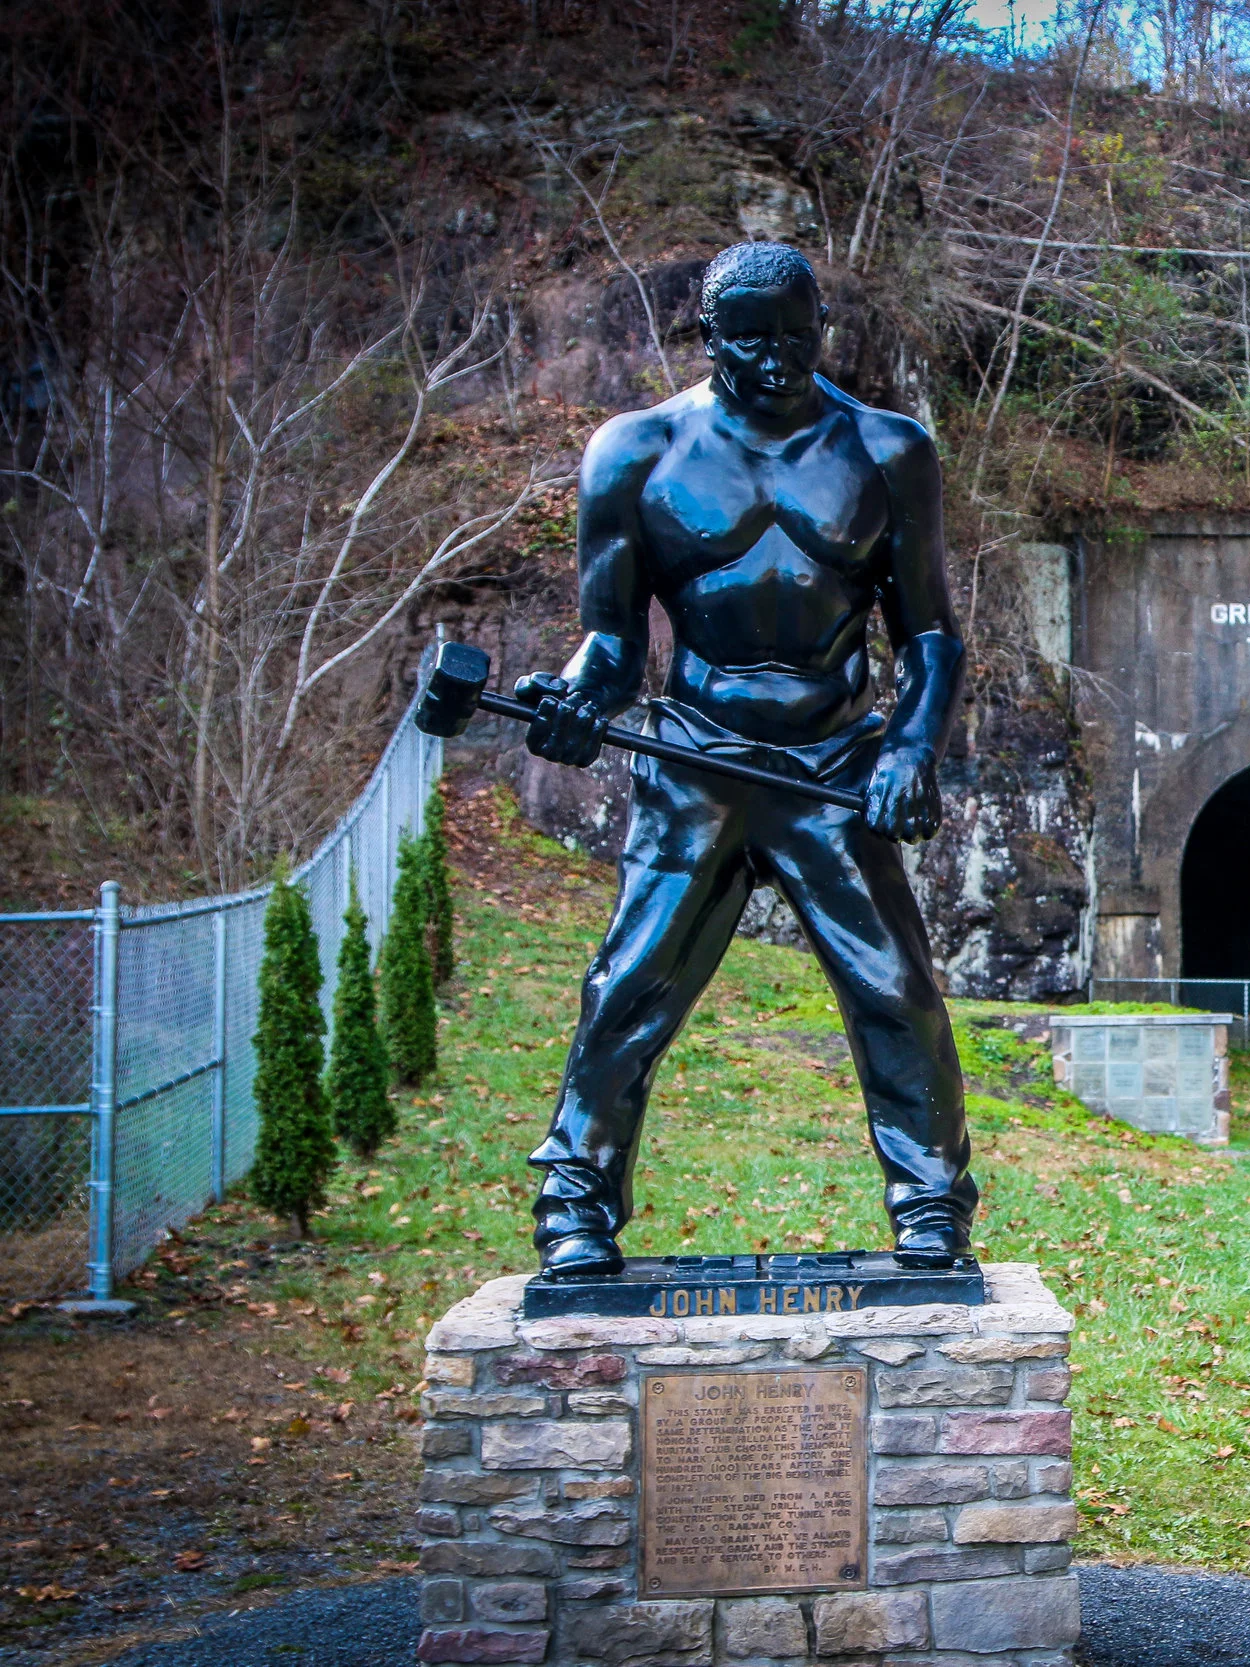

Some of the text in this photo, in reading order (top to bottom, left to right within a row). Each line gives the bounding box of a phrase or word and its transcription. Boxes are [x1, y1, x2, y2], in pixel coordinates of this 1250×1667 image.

[649, 1285, 866, 1317] JOHN HENRY
[695, 1383, 815, 1401] JOHN HENRY
[667, 1408, 689, 1417] THIS
[694, 1407, 732, 1416] STATUE
[738, 1406, 759, 1415] WAS
[764, 1405, 810, 1414] ERECTED
[656, 1413, 851, 1427] BY A GROUP OF PEOPLE WITH THE
[656, 1427, 684, 1436] SAME
[774, 1424, 787, 1433] AS
[792, 1423, 812, 1431] THE
[841, 1422, 851, 1430] IT
[712, 1435, 731, 1444] THE
[737, 1434, 787, 1443] HILLDALE
[705, 1445, 729, 1453] CLUB
[735, 1444, 769, 1452] CHOSE
[774, 1442, 795, 1451] THIS
[800, 1441, 851, 1450] MEMORIAL
[656, 1455, 671, 1464] TO
[678, 1455, 706, 1463] MARK
[714, 1454, 721, 1462] A
[728, 1453, 754, 1462] PAGE
[761, 1452, 775, 1460] OF
[831, 1449, 851, 1458] ONE
[656, 1464, 703, 1474] HUNDRED
[746, 1462, 781, 1471] YEARS
[790, 1461, 823, 1469] AFTER
[832, 1460, 851, 1468] THE
[656, 1473, 721, 1483] COMPLETION
[725, 1472, 739, 1480] OF
[743, 1471, 762, 1480] THE
[765, 1471, 782, 1479] BIG
[667, 1496, 694, 1505] JOHN
[701, 1494, 735, 1503] HENRY
[744, 1494, 766, 1502] DIED
[774, 1492, 803, 1501] FROM
[824, 1491, 851, 1499] RACE
[656, 1505, 682, 1514] WITH
[692, 1505, 712, 1513] THE
[724, 1503, 760, 1512] STEAM
[656, 1509, 851, 1524] CONSTRUCTION OF THE TUNNEL FOR
[656, 1524, 676, 1533] THE
[683, 1524, 694, 1532] C.
[700, 1523, 705, 1531] &
[778, 1520, 797, 1529] CO.
[665, 1530, 851, 1546] MAY GOD GRANT THAT WE ALWAYS
[656, 1540, 850, 1556] RESPECT THE GREAT AND THE STRONG
[656, 1550, 830, 1565] AND BE OF SERVICE TO OTHERS.
[764, 1564, 777, 1573] BY
[785, 1564, 795, 1572] W.
[812, 1562, 822, 1571] H.
